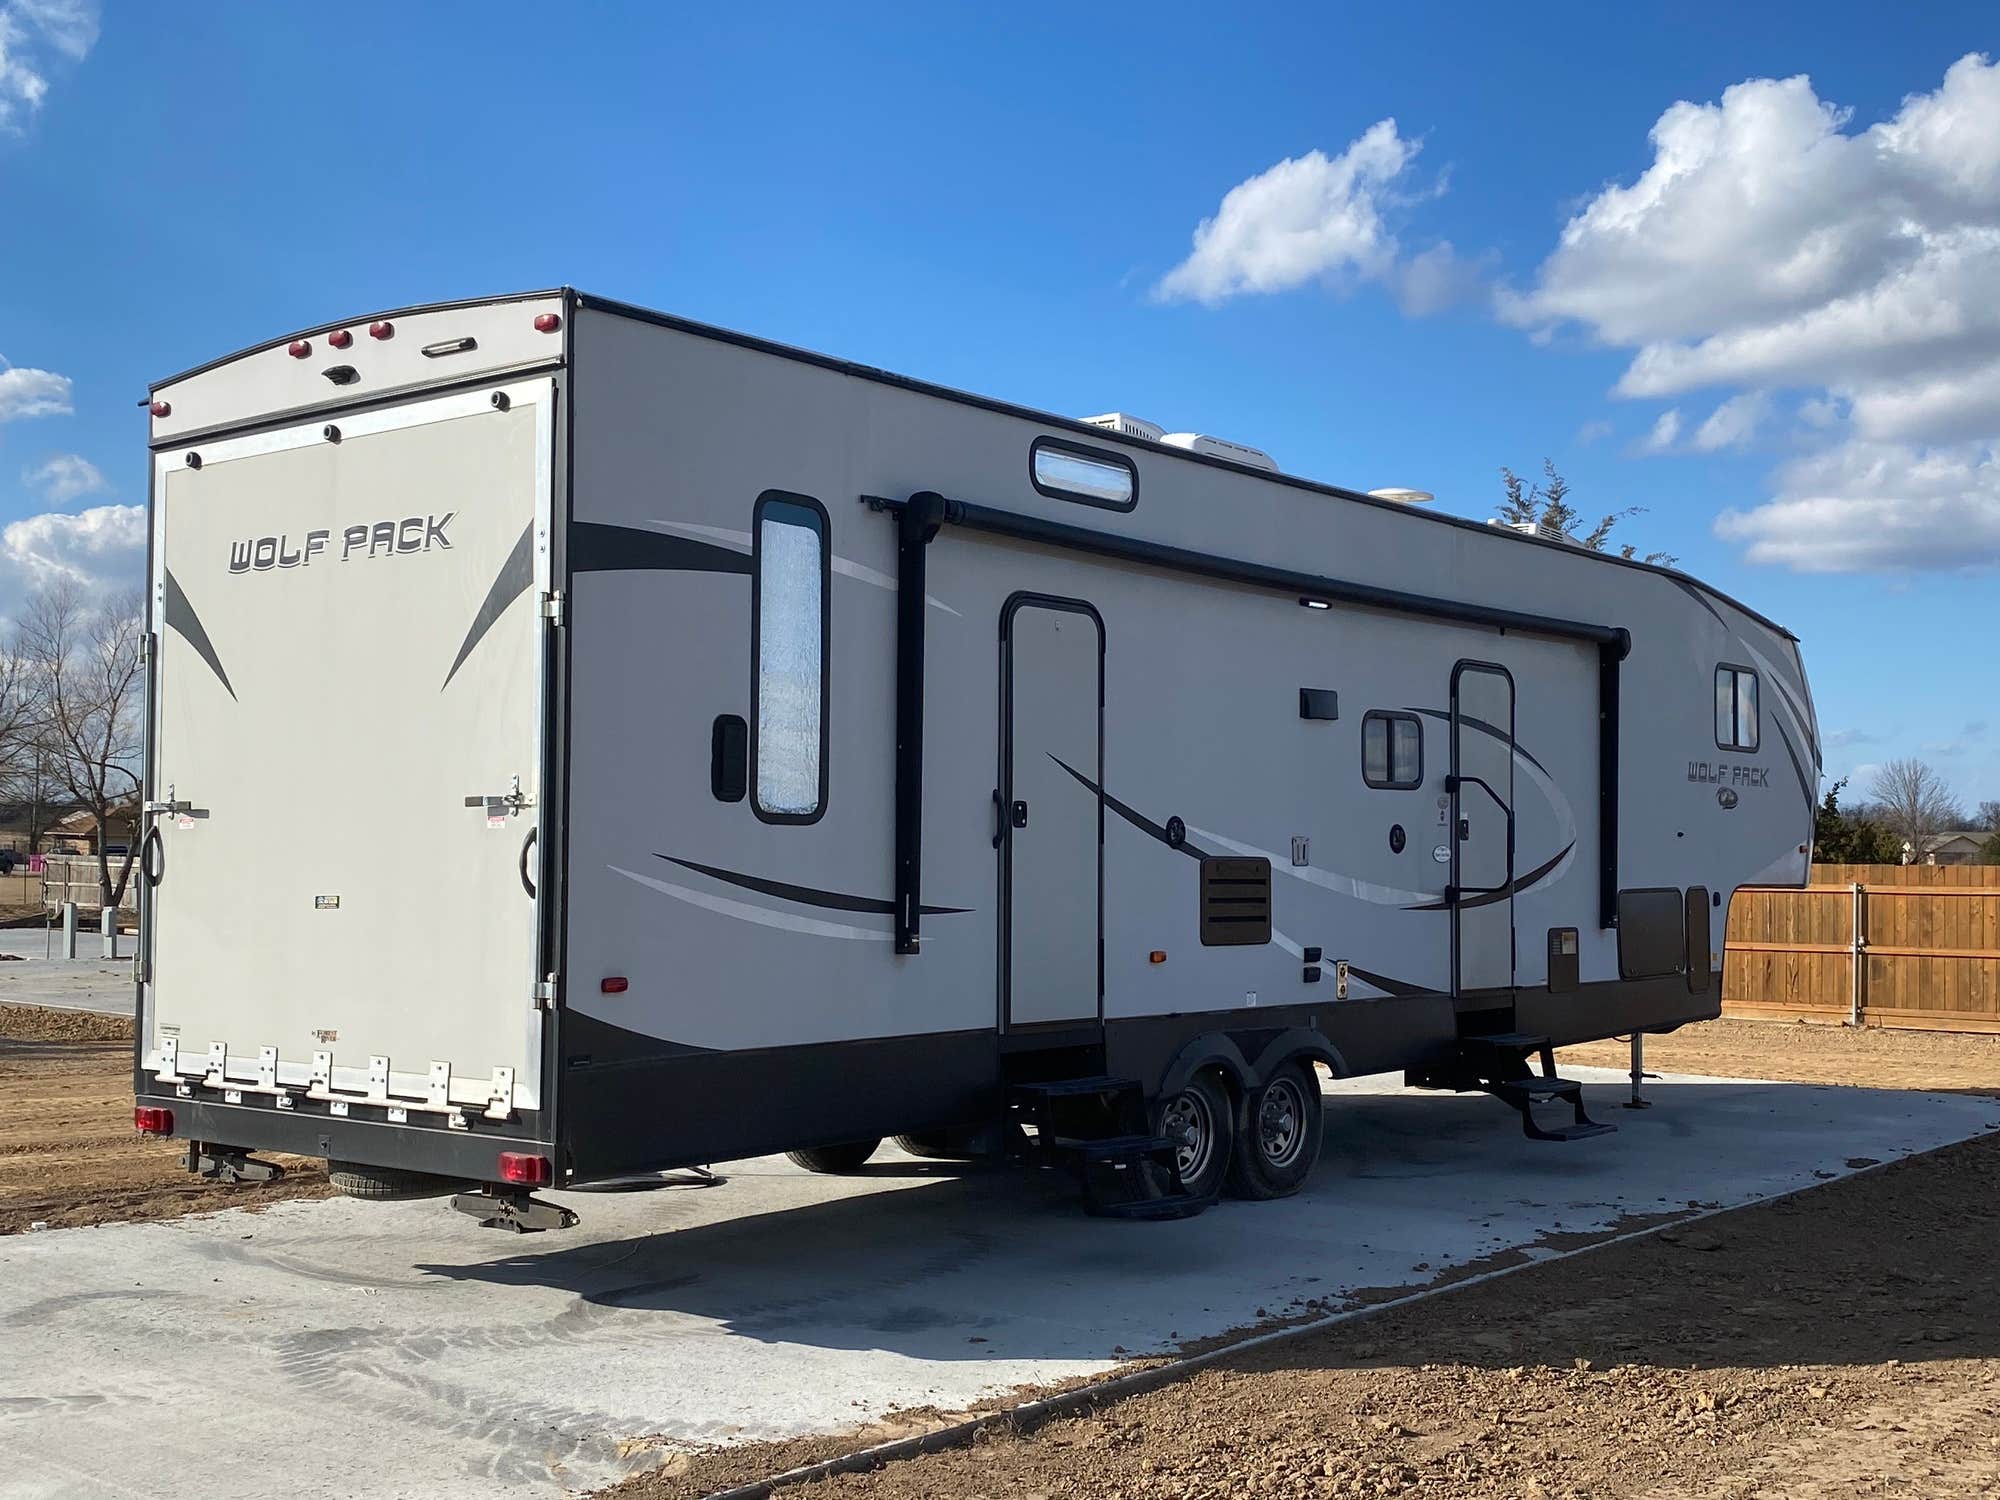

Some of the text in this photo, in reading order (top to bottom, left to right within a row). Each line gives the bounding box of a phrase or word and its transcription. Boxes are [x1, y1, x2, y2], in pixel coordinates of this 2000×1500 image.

[228, 511, 458, 575] WOLF PACK
[1687, 761, 1769, 788] WOLF PACK
